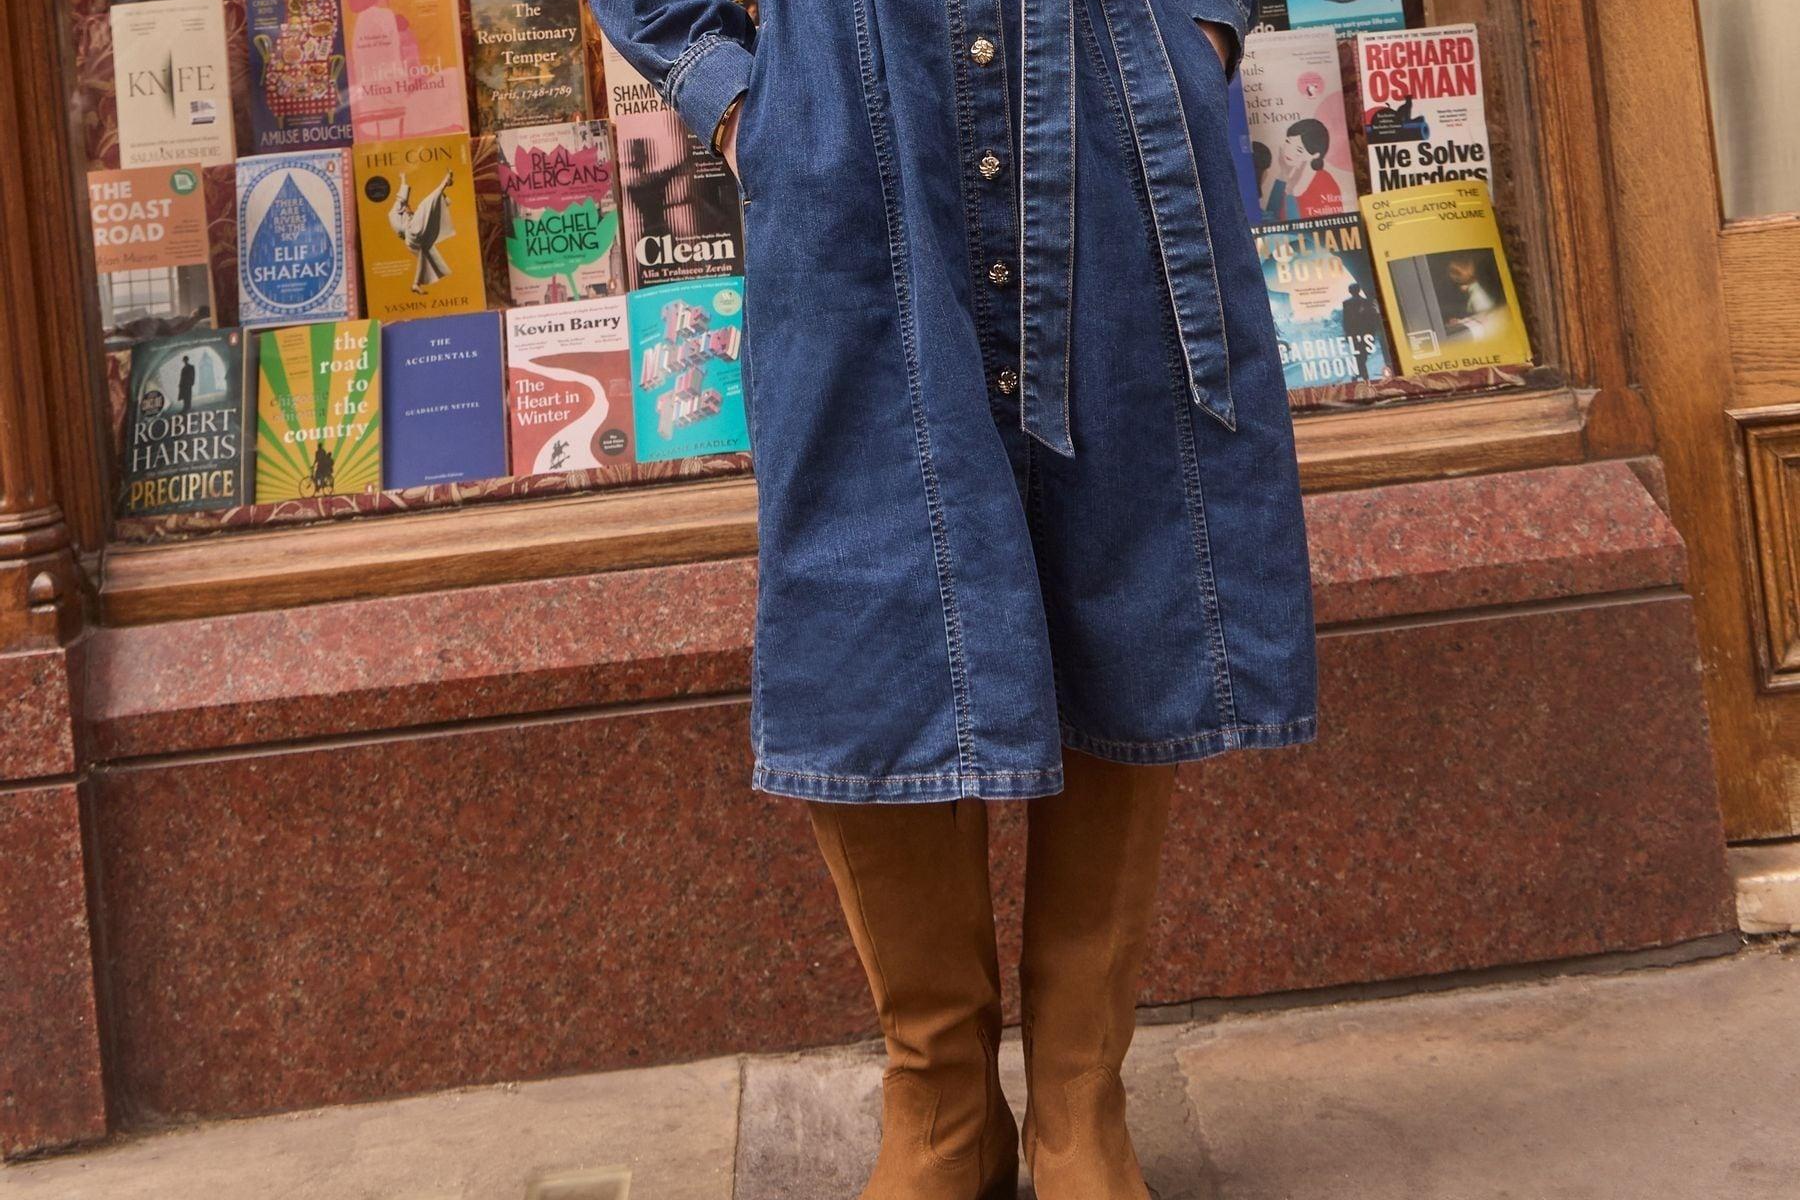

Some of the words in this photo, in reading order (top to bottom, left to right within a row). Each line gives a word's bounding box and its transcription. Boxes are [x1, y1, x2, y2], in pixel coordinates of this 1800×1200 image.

[511, 3, 542, 18] The
[478, 26, 577, 45] Revolutionary
[501, 49, 557, 69] Temper
[362, 81, 392, 97] Mina
[395, 78, 445, 94] Holland
[491, 88, 520, 103] Paris,
[521, 84, 573, 101] 1748-1789
[613, 83, 656, 102] SHAMI
[1369, 64, 1477, 103] OSMAN
[1263, 110, 1300, 124] Moon
[261, 128, 300, 147] AMUSE
[303, 125, 352, 144] BOUCHE
[366, 150, 399, 169] THE
[405, 146, 454, 164] COIN
[531, 150, 576, 172] REAL
[1375, 145, 1412, 169] We
[1418, 140, 1485, 166] Solve
[505, 166, 610, 193] AMERICANS
[1379, 163, 1488, 192] Murders
[91, 181, 132, 201] THE
[1372, 199, 1390, 210] ON
[1455, 188, 1480, 198] THE
[92, 199, 172, 224] COAST
[1375, 199, 1457, 220] CALCULATION
[1378, 221, 1394, 232] OF
[1438, 209, 1485, 221] VOLUME
[525, 212, 597, 238] RACHEL
[1292, 221, 1313, 230] TIMES
[1314, 215, 1359, 228] BESTSELLER
[95, 223, 165, 246] ROAD
[526, 232, 600, 257] KHONG
[1255, 226, 1363, 260] WILLIAM
[274, 244, 309, 262] ELIF
[635, 234, 736, 267] Clean
[254, 261, 329, 283] SHAFAK
[1276, 255, 1344, 285] BOYD
[384, 300, 428, 315] YASMIN
[431, 296, 470, 310] ZAHER
[514, 320, 565, 337] Kevin
[570, 315, 621, 332] Barry
[334, 331, 369, 351] the
[430, 337, 451, 347] THE
[1278, 333, 1377, 364] GABRIEL'S
[320, 350, 369, 374] road
[405, 350, 479, 366] ACCIDENTALS
[1412, 359, 1459, 375] SOLVEJ
[1461, 354, 1501, 367] BALLE
[1303, 356, 1361, 383] MOON
[347, 377, 368, 393] to
[515, 379, 545, 394] The
[334, 395, 368, 416] the
[405, 404, 450, 417] GUADALUPE
[452, 400, 480, 412] NETTEL
[516, 392, 562, 411] Heart
[565, 390, 580, 404] in
[134, 407, 236, 446] ROBERT
[517, 408, 571, 427] Winter
[284, 422, 370, 444] country
[131, 433, 236, 473] HARRIS
[130, 469, 235, 510] PRECIPICE
